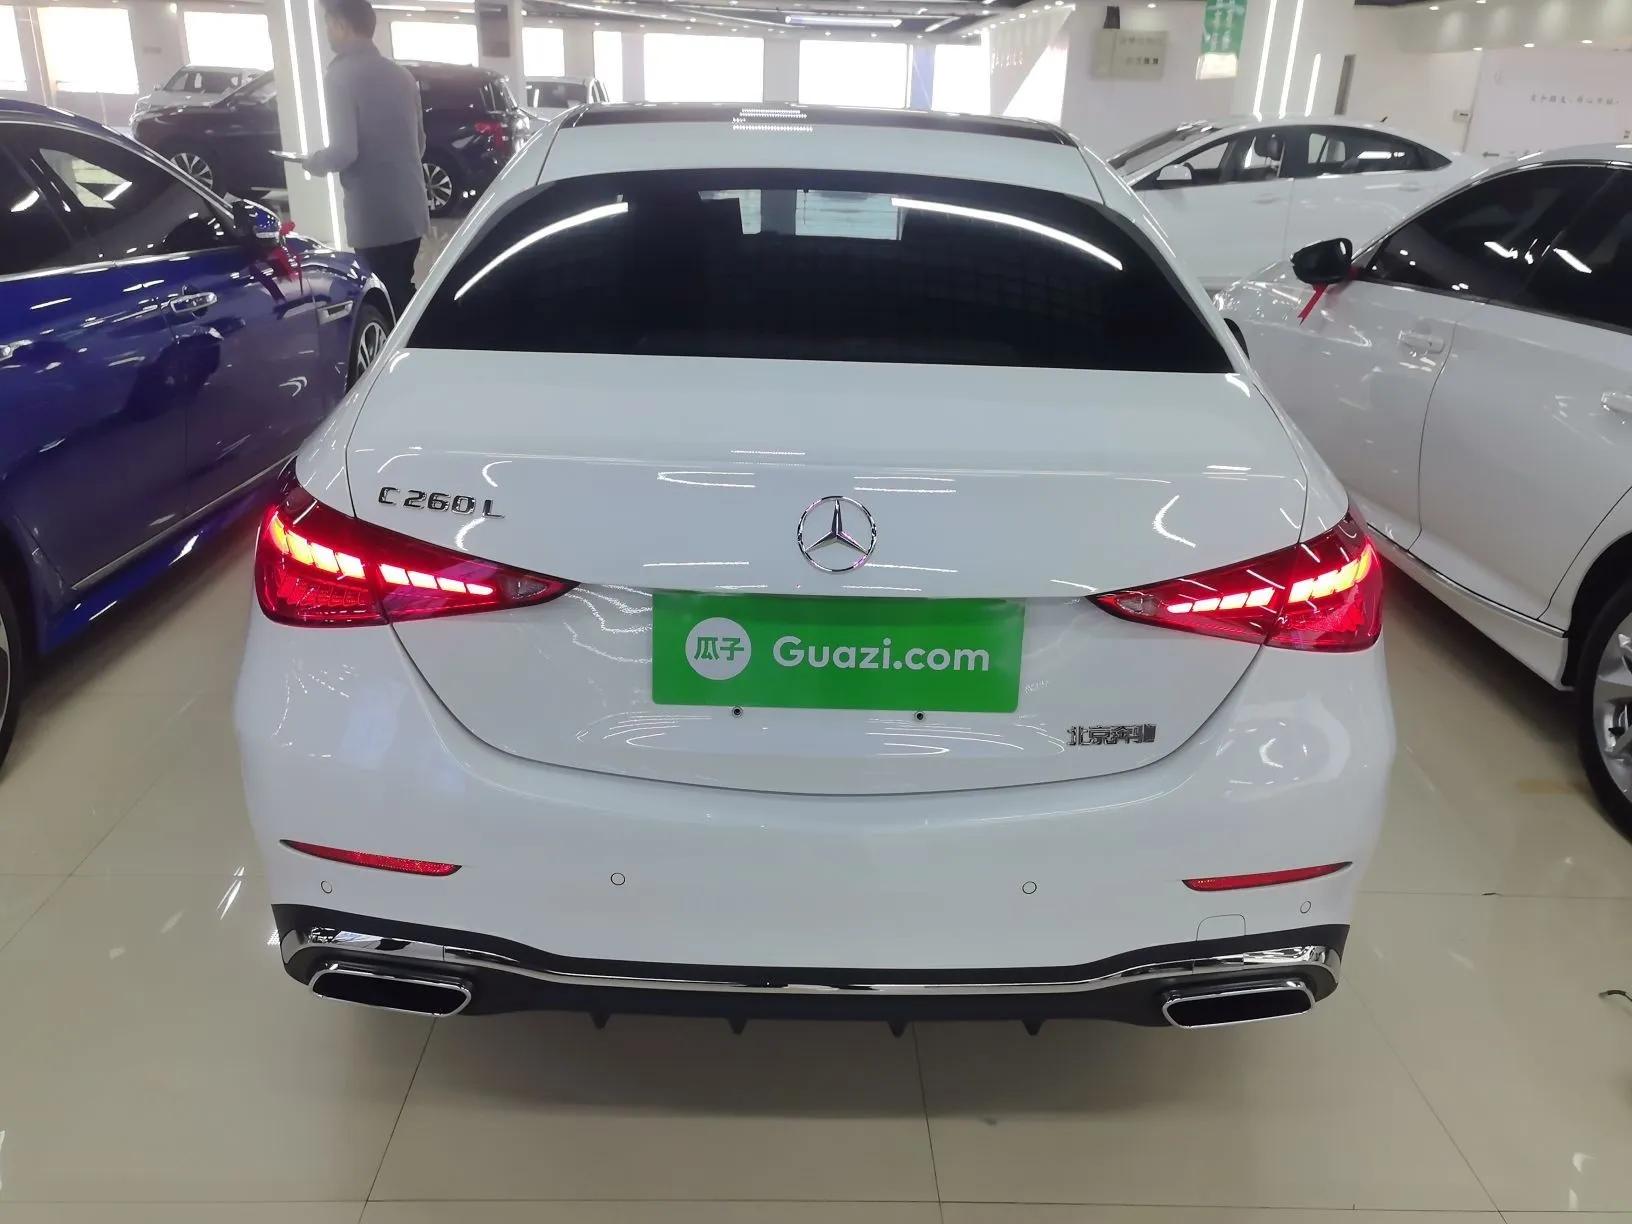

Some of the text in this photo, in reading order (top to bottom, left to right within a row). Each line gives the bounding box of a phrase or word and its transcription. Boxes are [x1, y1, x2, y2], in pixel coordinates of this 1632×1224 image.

[378, 486, 505, 519] C 260 L
